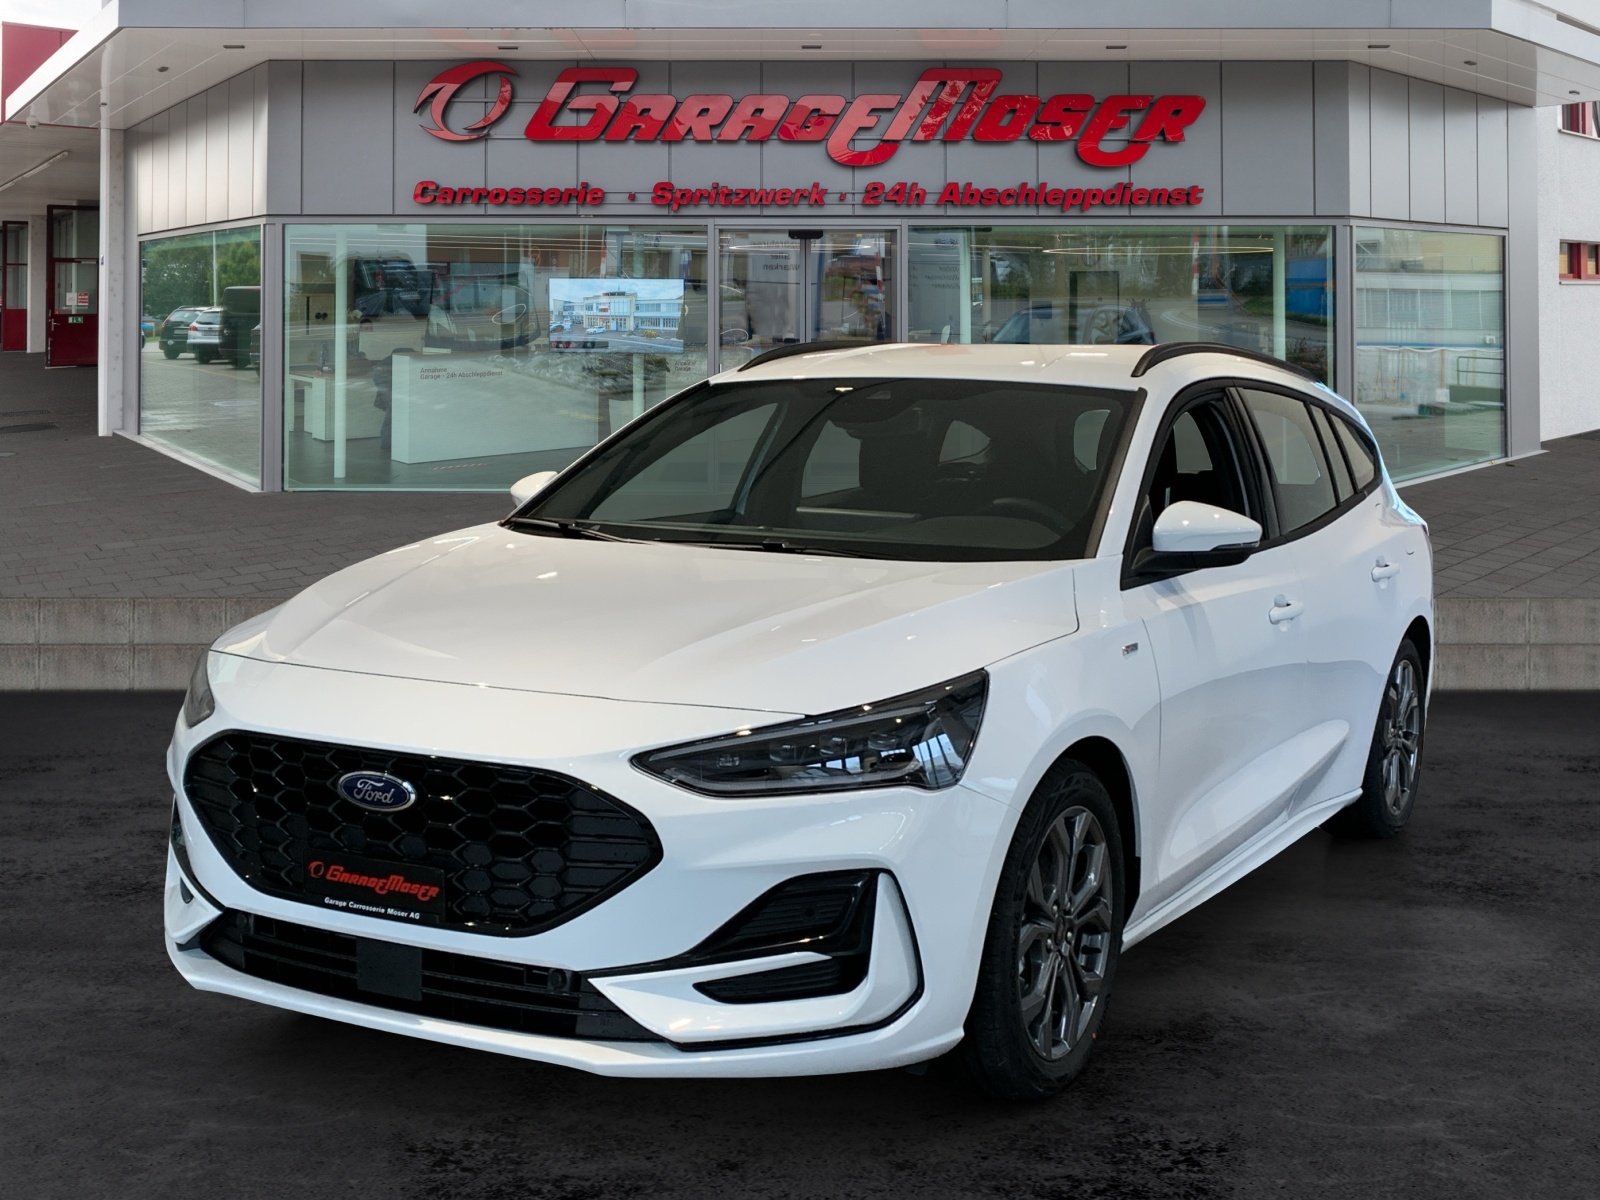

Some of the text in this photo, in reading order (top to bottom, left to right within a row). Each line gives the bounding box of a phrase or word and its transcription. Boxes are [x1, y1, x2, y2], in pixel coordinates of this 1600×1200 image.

[413, 181, 1204, 211] Carrosserie Spritzwerk 24h Abschleppdienst
[353, 778, 395, 804] Ford
[324, 896, 347, 907] Garage
[348, 901, 385, 914] Carrosserie
[387, 907, 408, 917] Moser
